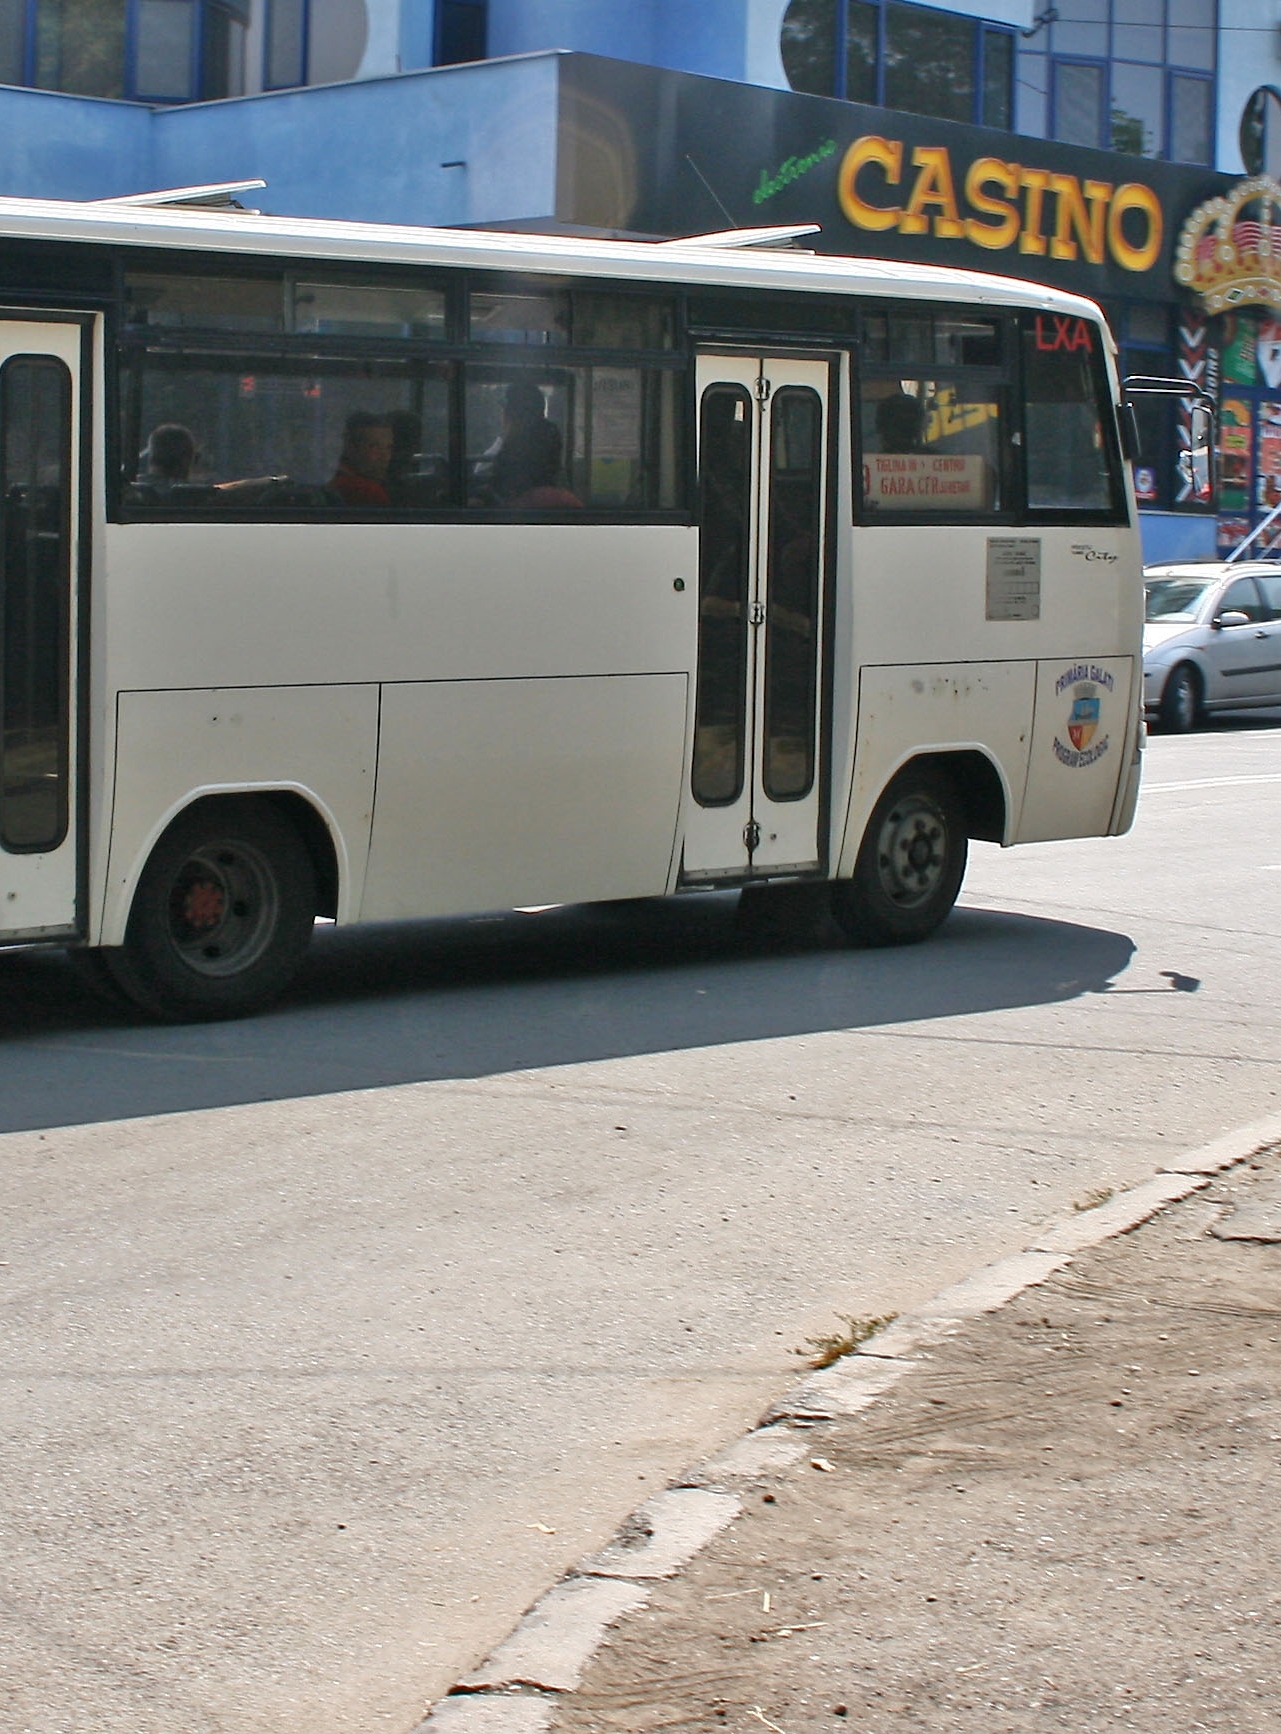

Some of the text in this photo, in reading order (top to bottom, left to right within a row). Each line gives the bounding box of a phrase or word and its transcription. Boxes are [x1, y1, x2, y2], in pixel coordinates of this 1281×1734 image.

[838, 135, 1163, 272] CASINO
[1036, 315, 1093, 353] LXA
[880, 476, 915, 496] GARA
